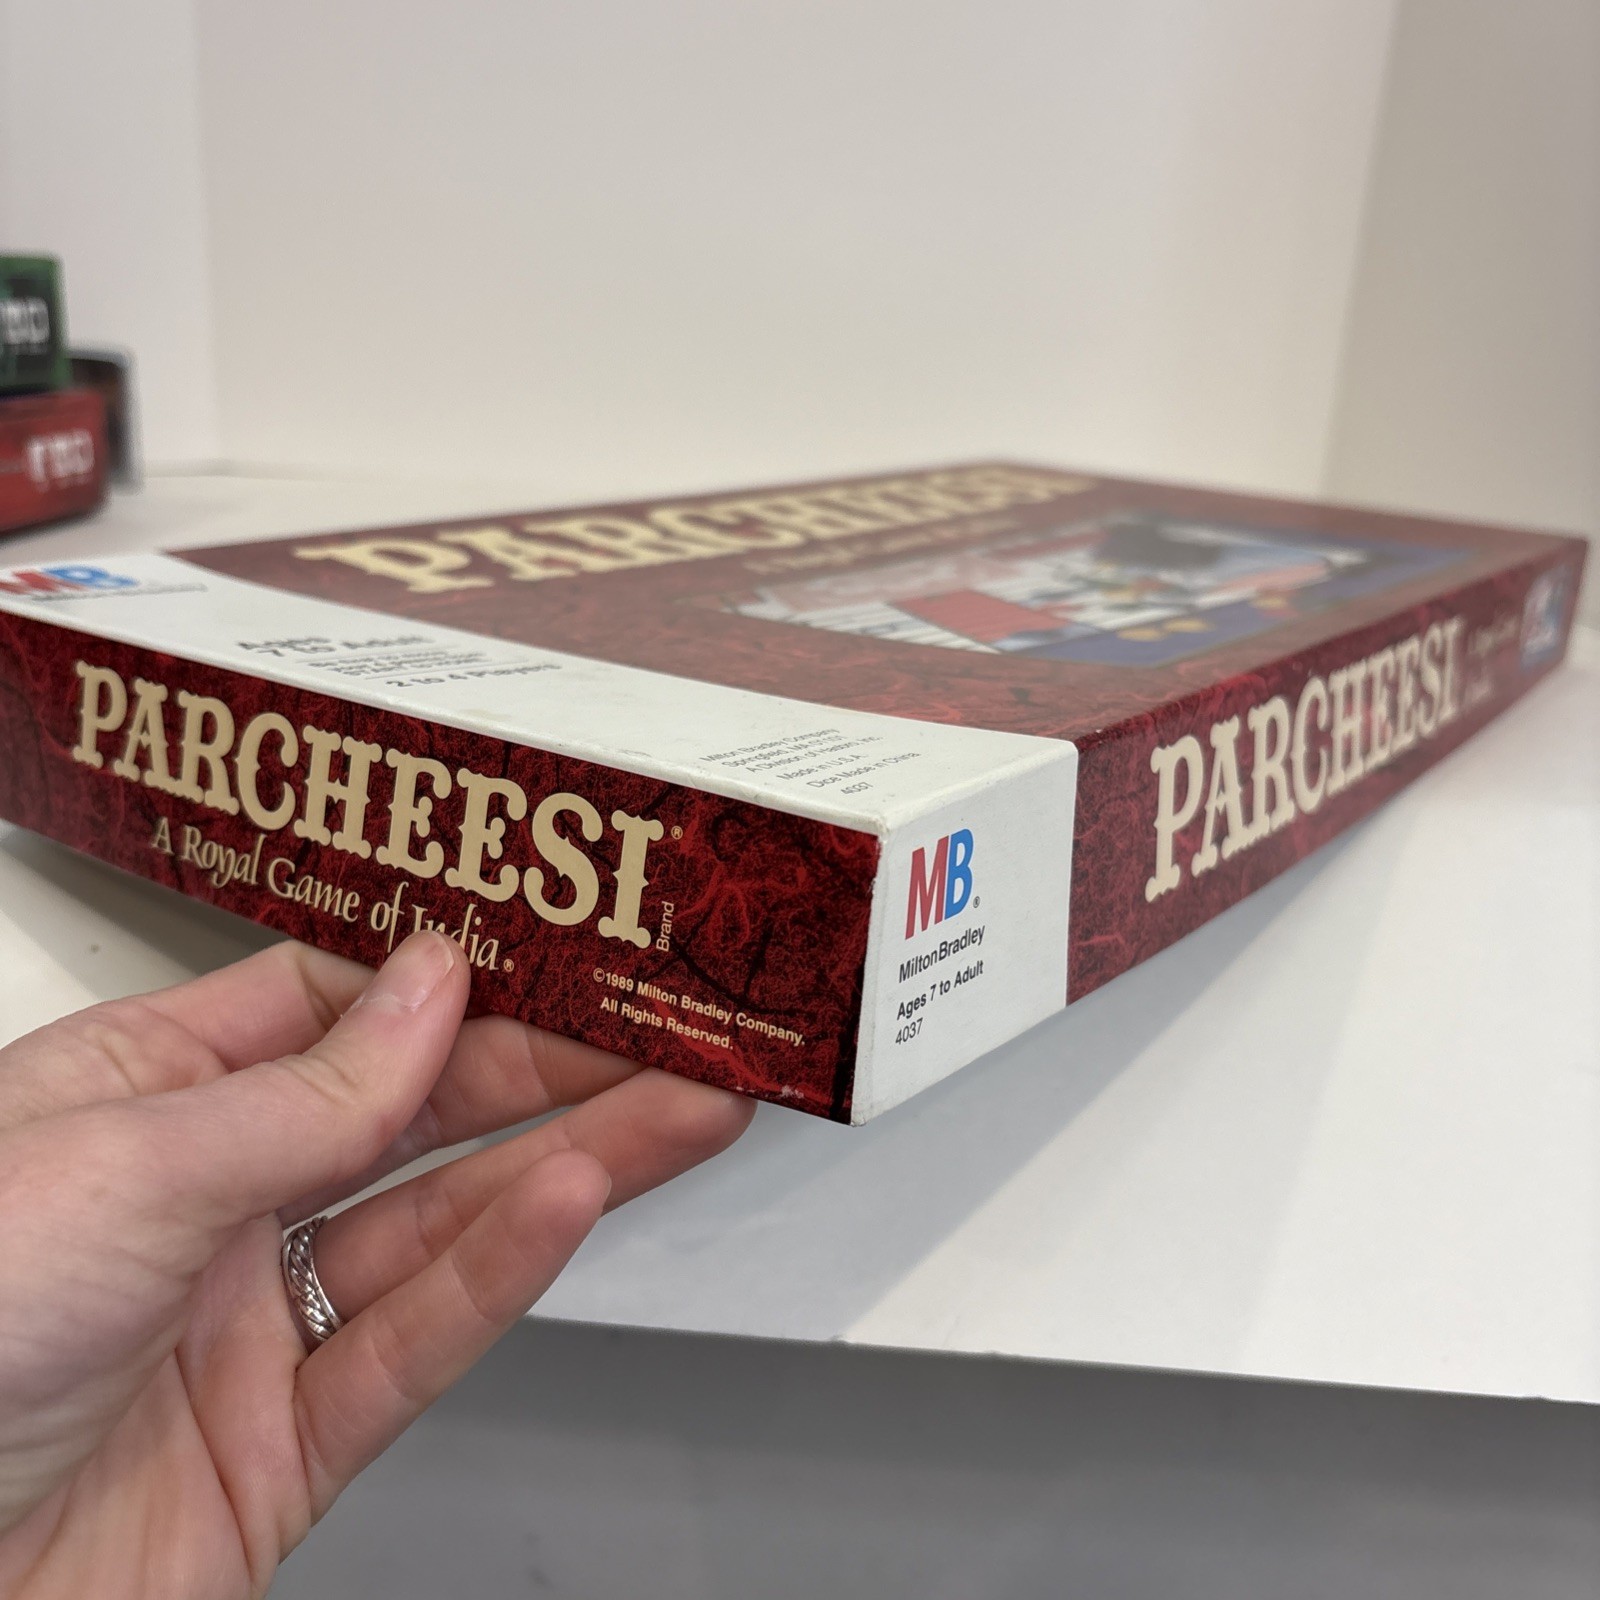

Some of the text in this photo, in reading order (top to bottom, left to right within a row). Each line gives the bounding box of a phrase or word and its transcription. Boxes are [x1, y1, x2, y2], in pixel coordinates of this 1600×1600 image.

[699, 751, 744, 762] Milton
[737, 741, 788, 753] Bradley
[755, 755, 807, 769] Division
[806, 777, 842, 788] Dice
[835, 767, 876, 777] Made
[882, 752, 921, 763] China
[1145, 615, 1463, 902] PARCHEESI
[776, 767, 818, 780] Made
[840, 782, 873, 794] 4037
[151, 817, 174, 857] A
[181, 825, 267, 889] Royal
[267, 857, 360, 923] Game
[370, 882, 409, 953] of
[656, 901, 675, 952] Brand
[593, 967, 805, 1047] ©1989 Milton Bradley Company.
[897, 960, 984, 1020] Ages 7 to Adult
[600, 997, 734, 1050] All Rights Reserved.
[895, 1018, 923, 1045] 4037
